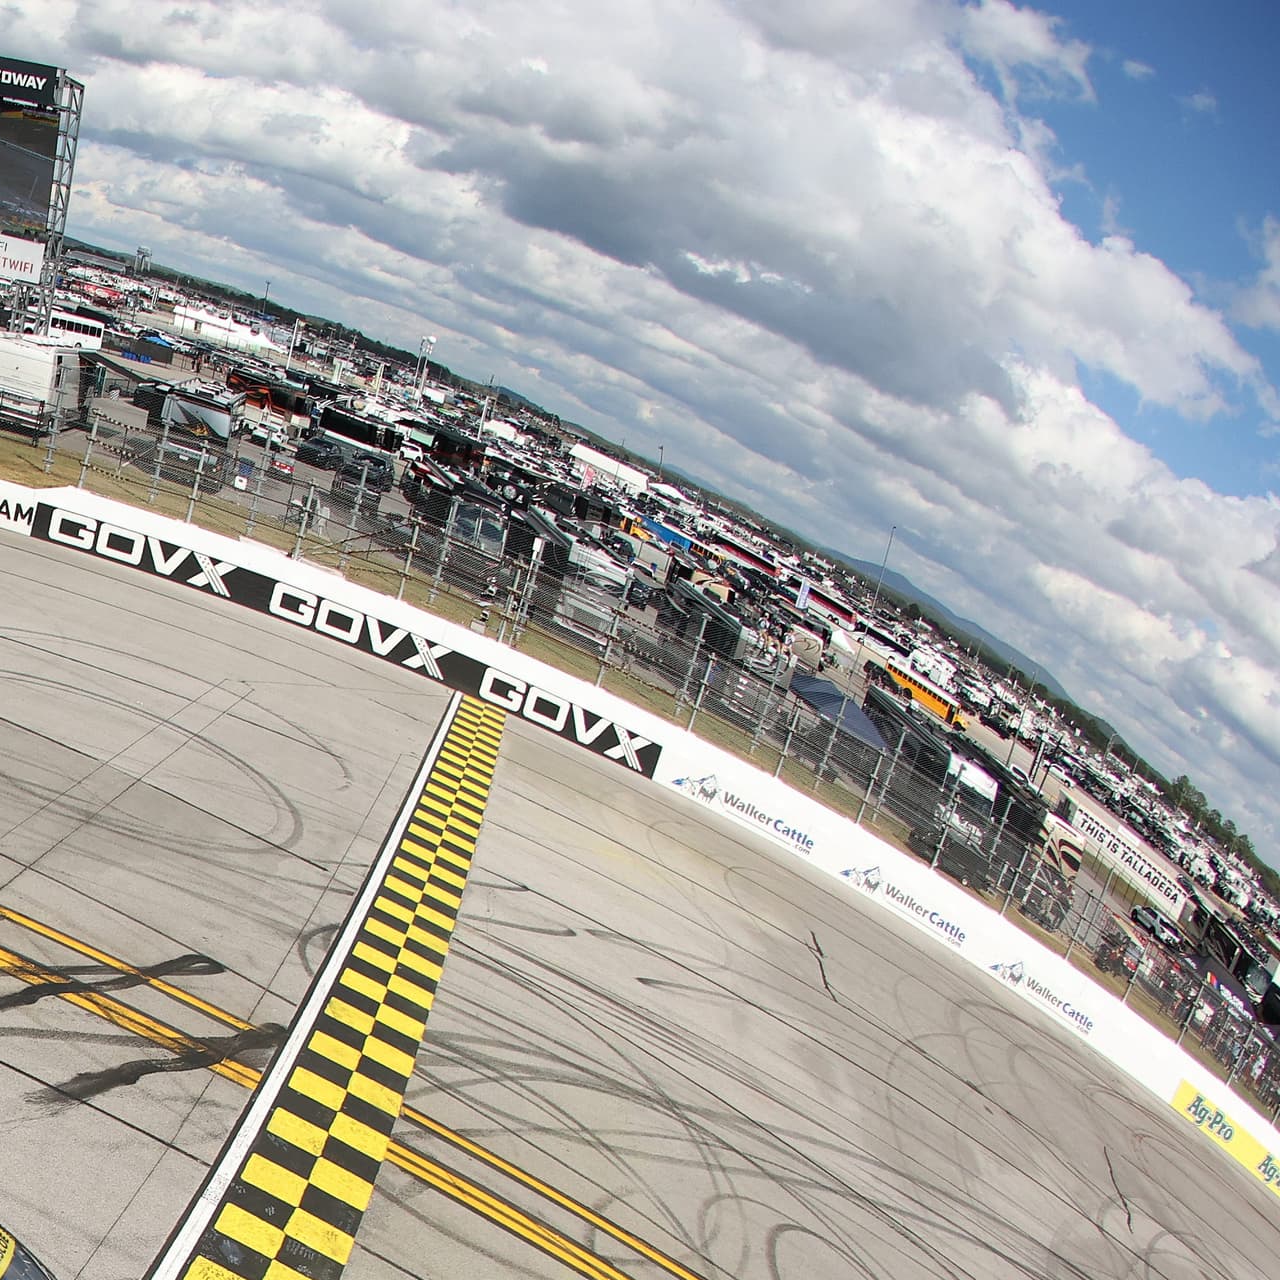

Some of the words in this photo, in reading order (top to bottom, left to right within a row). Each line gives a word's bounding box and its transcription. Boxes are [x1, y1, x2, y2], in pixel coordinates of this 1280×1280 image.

[47, 508, 241, 598] GOVX
[267, 580, 455, 681] GOVX
[477, 667, 655, 773] GOVX
[1079, 817, 1107, 843] THIS
[1107, 837, 1119, 852] IS
[1120, 850, 1180, 904] TALLADEGA
[1188, 1095, 1234, 1142] Ag-Pro
[1258, 1153, 1280, 1189] Ag-
